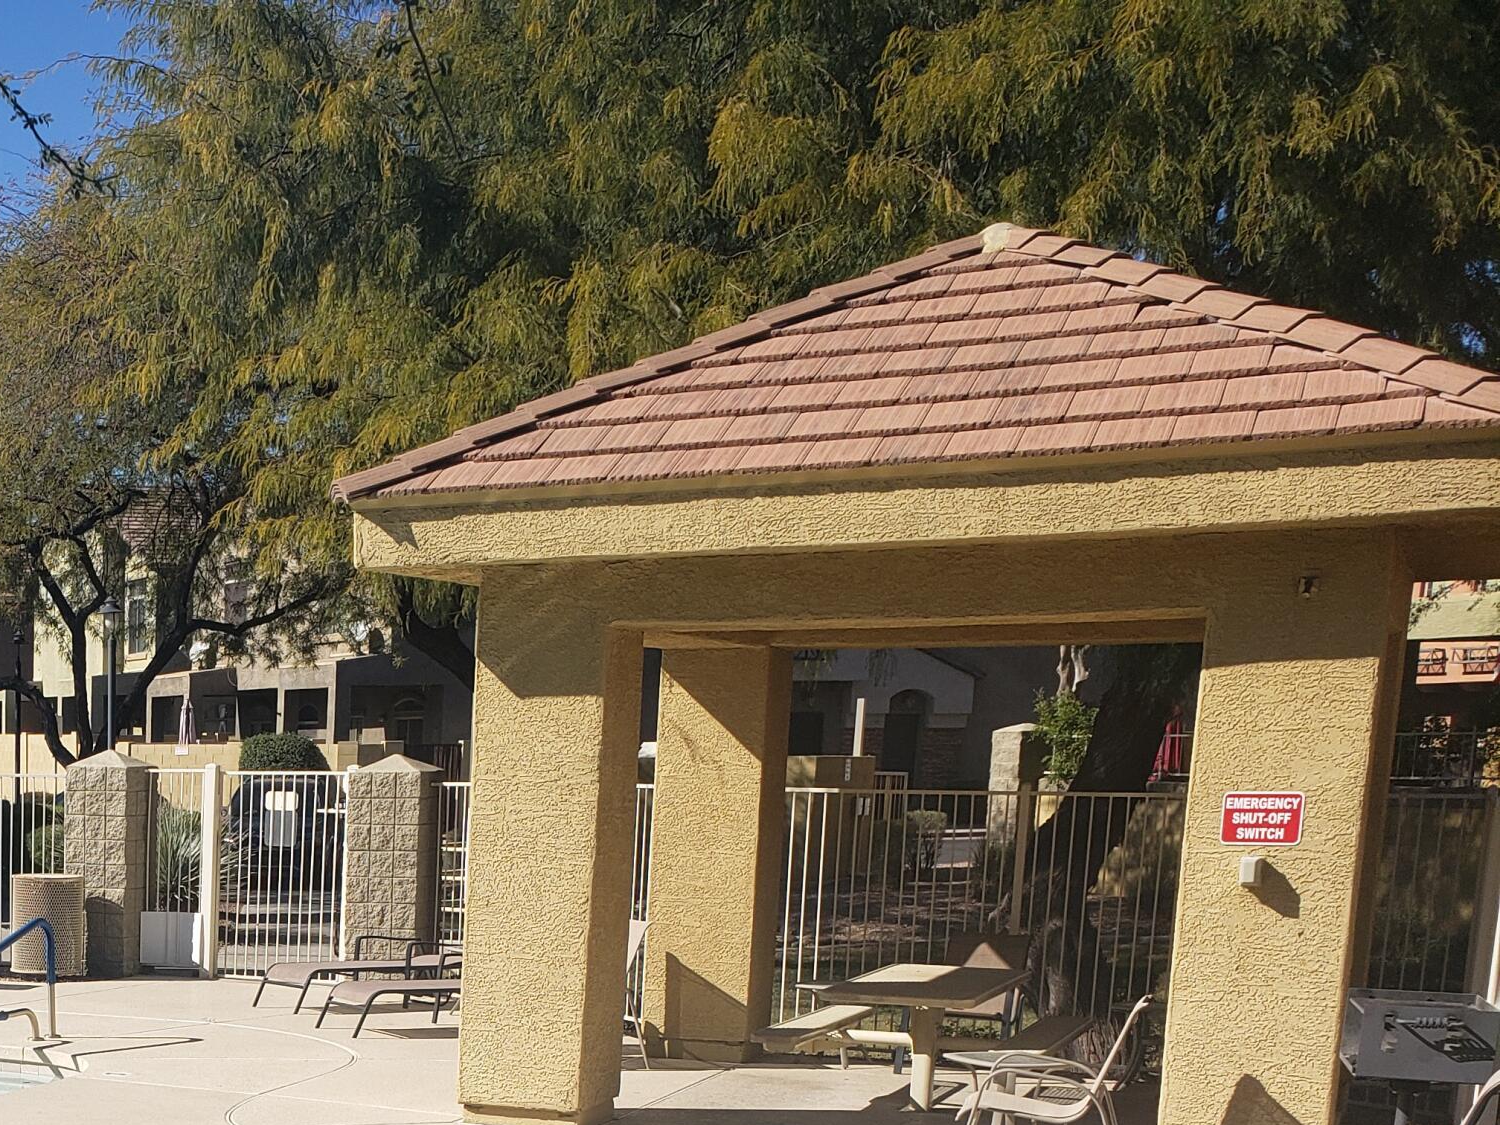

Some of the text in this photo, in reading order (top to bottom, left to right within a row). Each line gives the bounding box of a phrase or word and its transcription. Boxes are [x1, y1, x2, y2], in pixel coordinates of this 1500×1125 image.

[1225, 797, 1300, 810] EMERGENCY
[1231, 812, 1292, 825] SHUT-OFF
[1235, 827, 1285, 840] SWITCH
